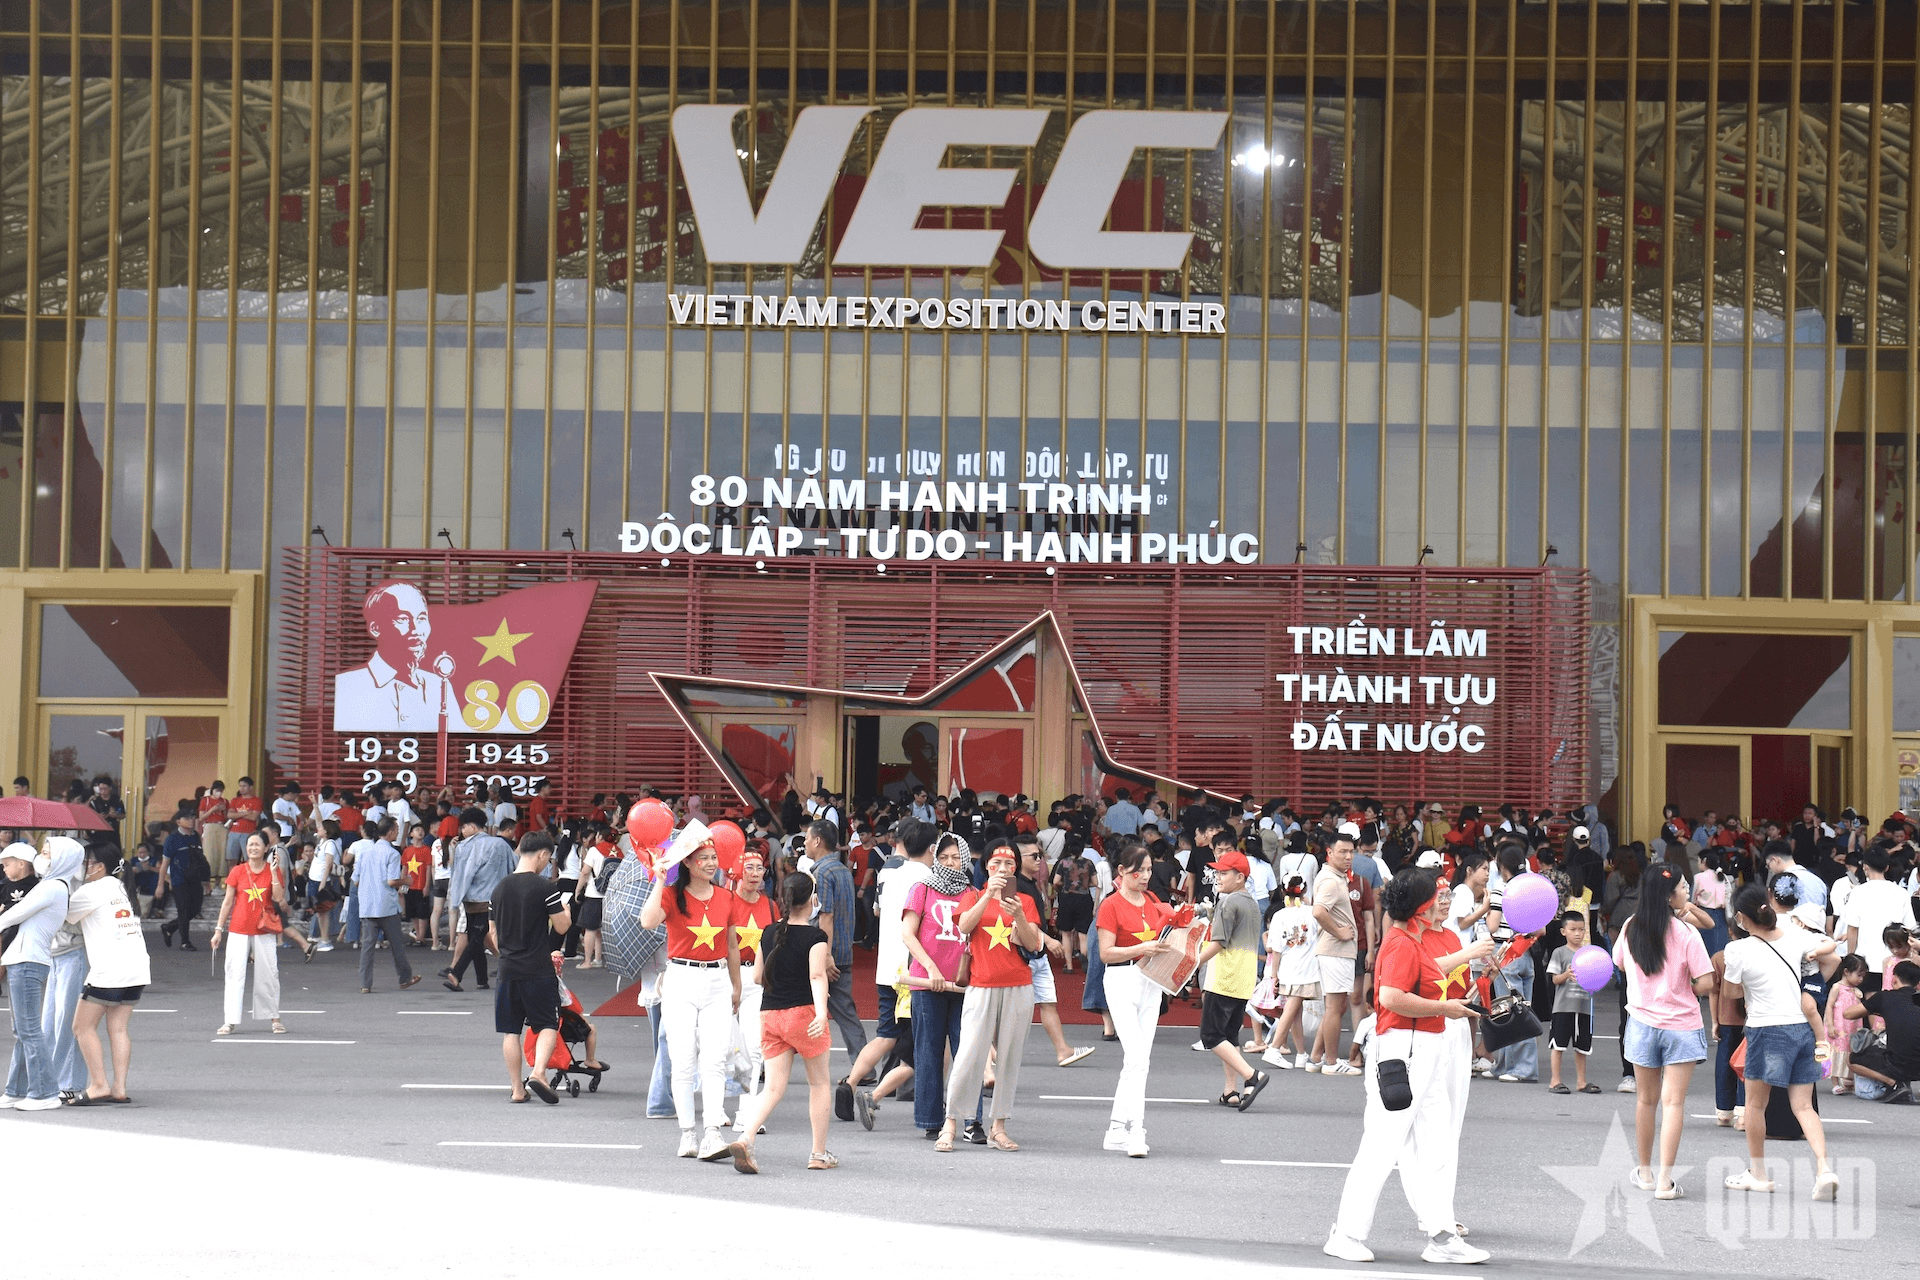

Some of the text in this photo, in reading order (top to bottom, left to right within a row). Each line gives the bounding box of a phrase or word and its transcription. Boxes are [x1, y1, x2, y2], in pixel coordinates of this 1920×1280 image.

[671, 104, 1229, 271] VEC
[668, 293, 1226, 334] VIETNAM EXPOSITION CENTER
[689, 466, 1151, 515] 80 NĂM HÀNH TRÌNH
[618, 512, 712, 567] ĐỘC
[721, 515, 804, 570] LẬP
[840, 525, 900, 573] TỰ
[906, 529, 966, 561] DO
[1003, 530, 1132, 576] HẠNH
[1141, 520, 1259, 565] PHÚC
[1286, 613, 1487, 657] TRIỂN LÃM
[462, 679, 550, 732] 80
[1276, 666, 1496, 715] THÀNH TỰU
[344, 737, 420, 763] 19-8
[465, 742, 550, 765] 1945
[1290, 709, 1485, 753] ĐẤT NƯỚC
